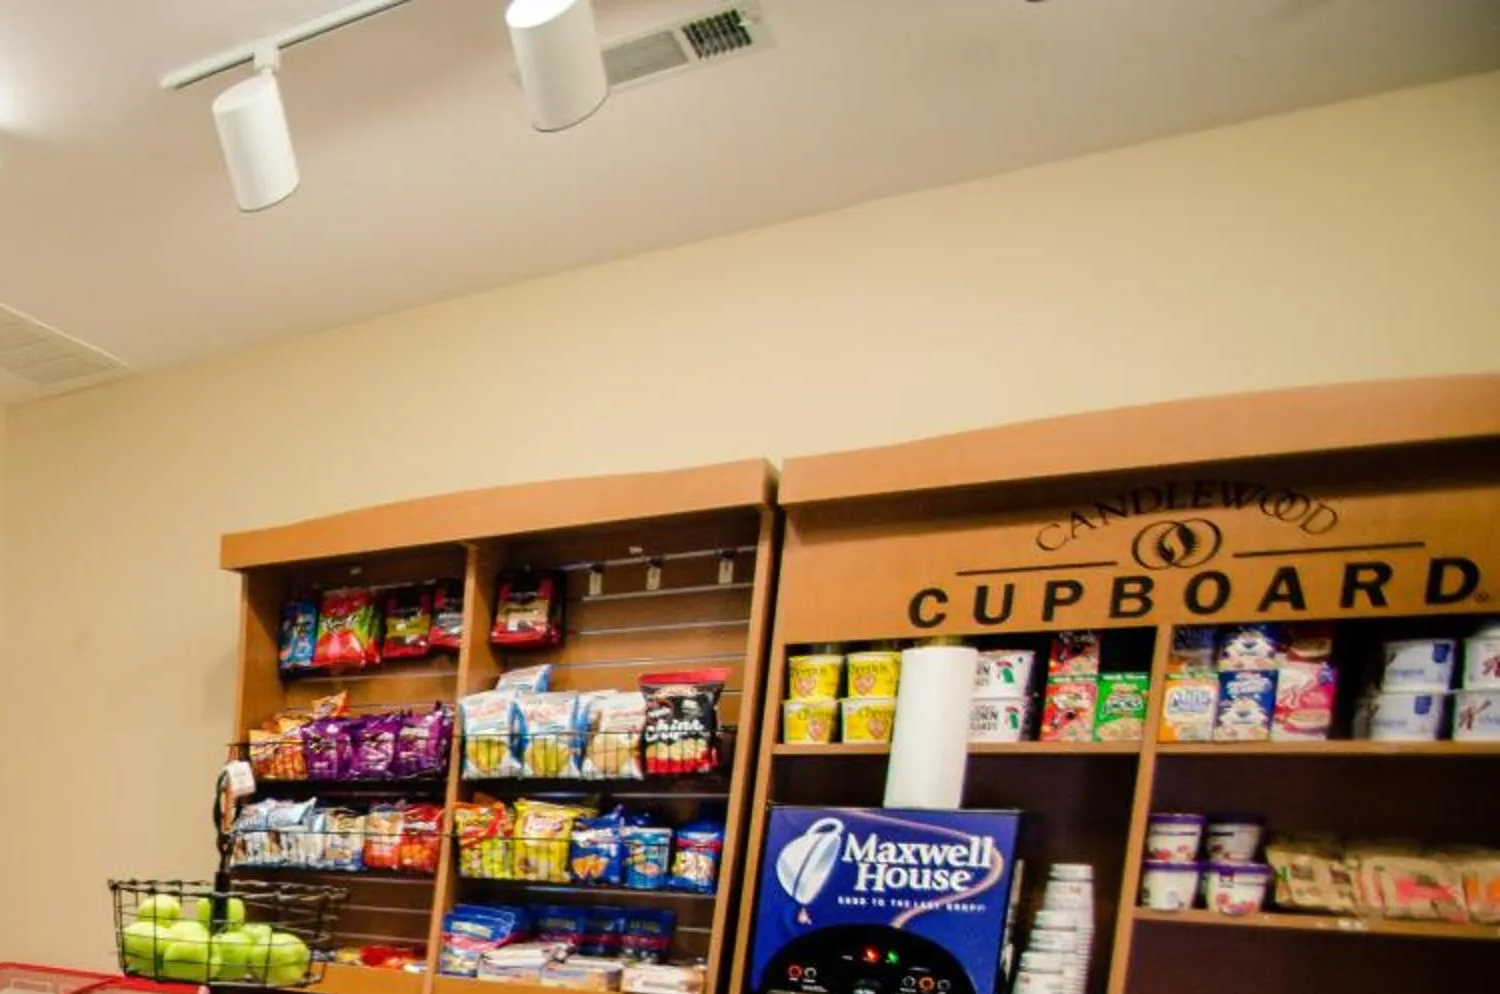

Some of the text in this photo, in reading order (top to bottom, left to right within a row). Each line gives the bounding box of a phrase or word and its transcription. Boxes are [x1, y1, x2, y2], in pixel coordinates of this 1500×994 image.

[1035, 479, 1339, 551] CANDLEWOOD
[908, 556, 1482, 629] CUPBOARD
[841, 832, 994, 867] Maxwell
[853, 863, 972, 892] House
